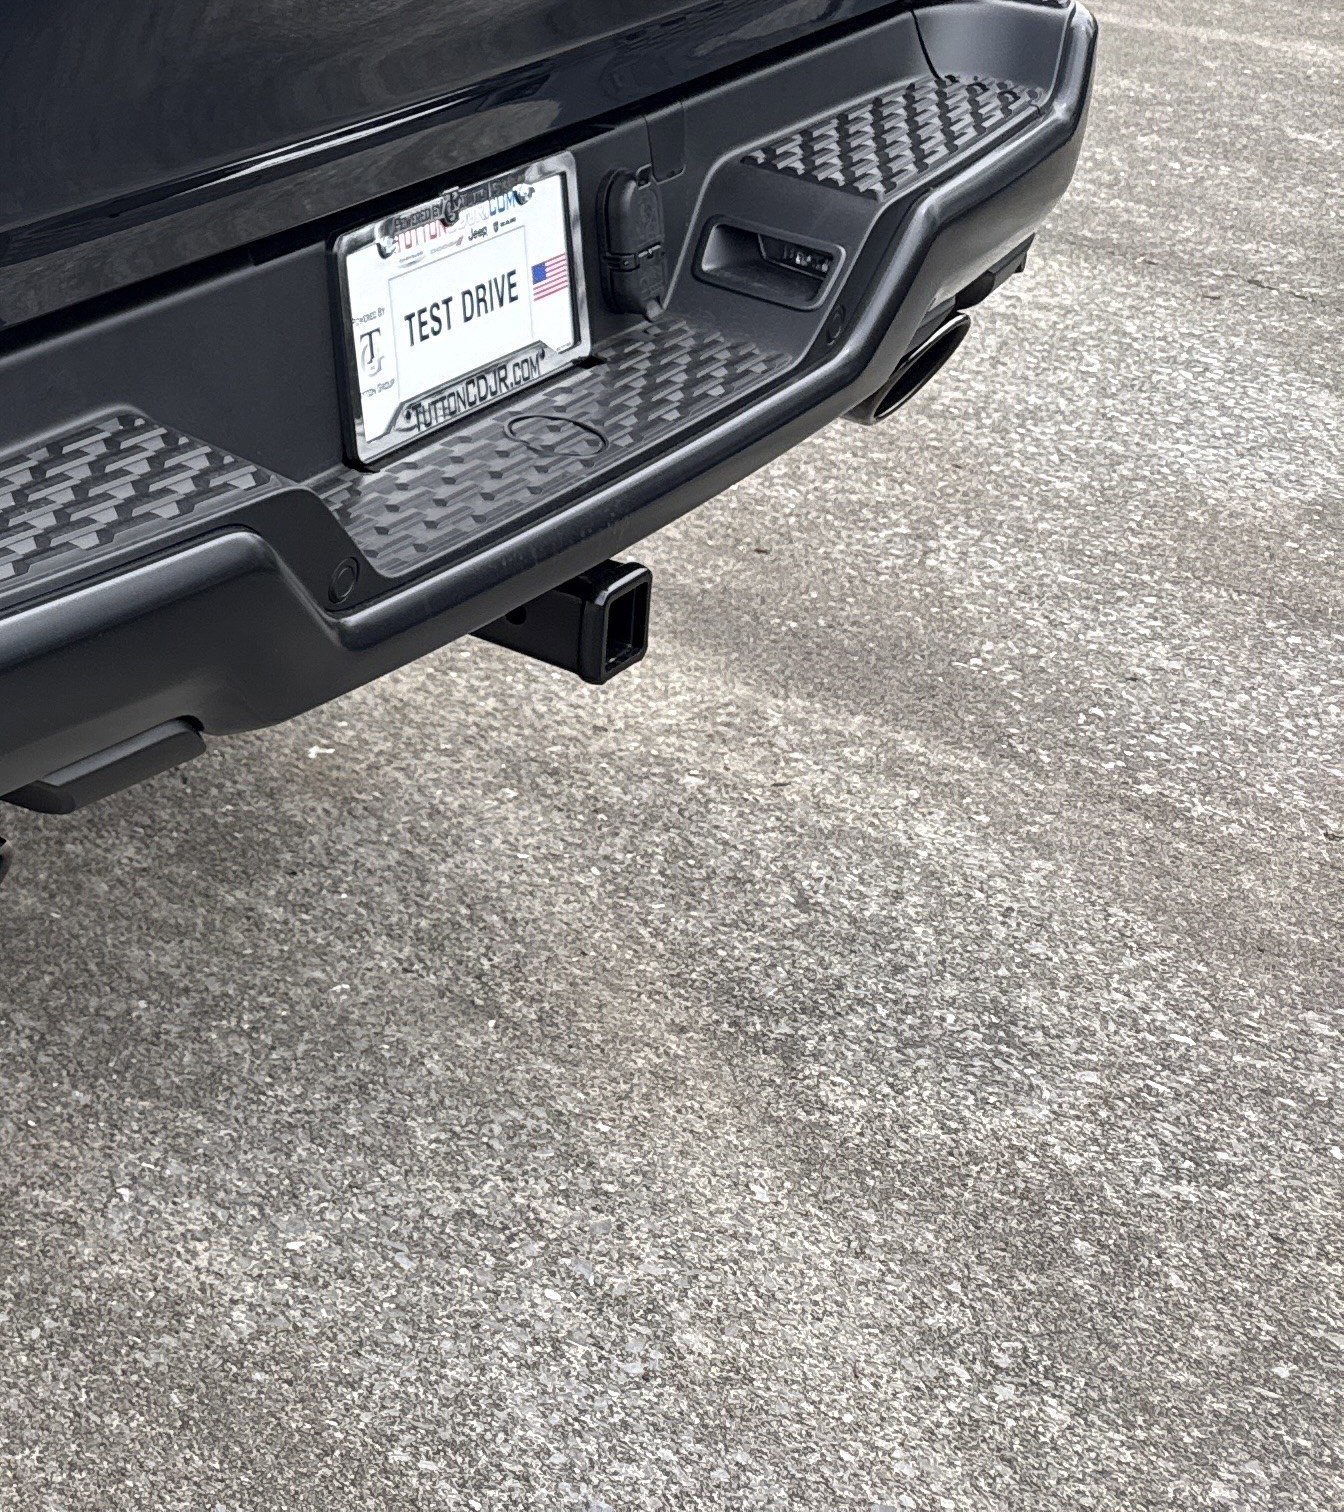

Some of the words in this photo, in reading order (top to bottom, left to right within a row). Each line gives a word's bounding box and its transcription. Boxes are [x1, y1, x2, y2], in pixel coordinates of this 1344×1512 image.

[468, 226, 488, 241] Jeep
[404, 296, 453, 347] TEST
[461, 269, 519, 323] DRIVE
